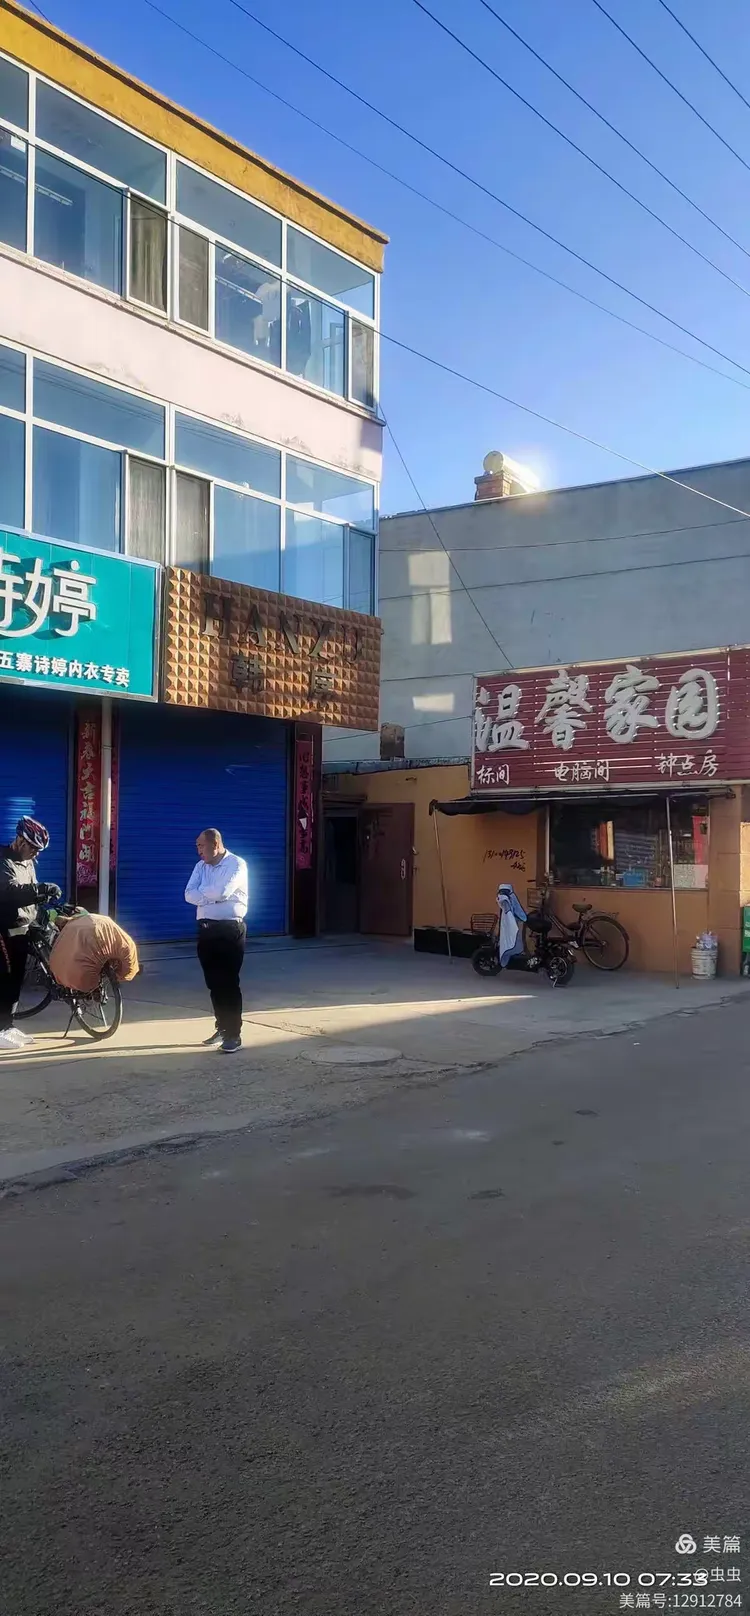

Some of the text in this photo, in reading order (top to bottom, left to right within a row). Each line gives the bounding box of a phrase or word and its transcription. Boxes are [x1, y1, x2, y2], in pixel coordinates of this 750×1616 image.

[0, 651, 130, 688] 五寨诗婷内衣专卖
[475, 664, 721, 752] 温馨家园
[476, 750, 720, 786] 标间 电脑间 钟点房
